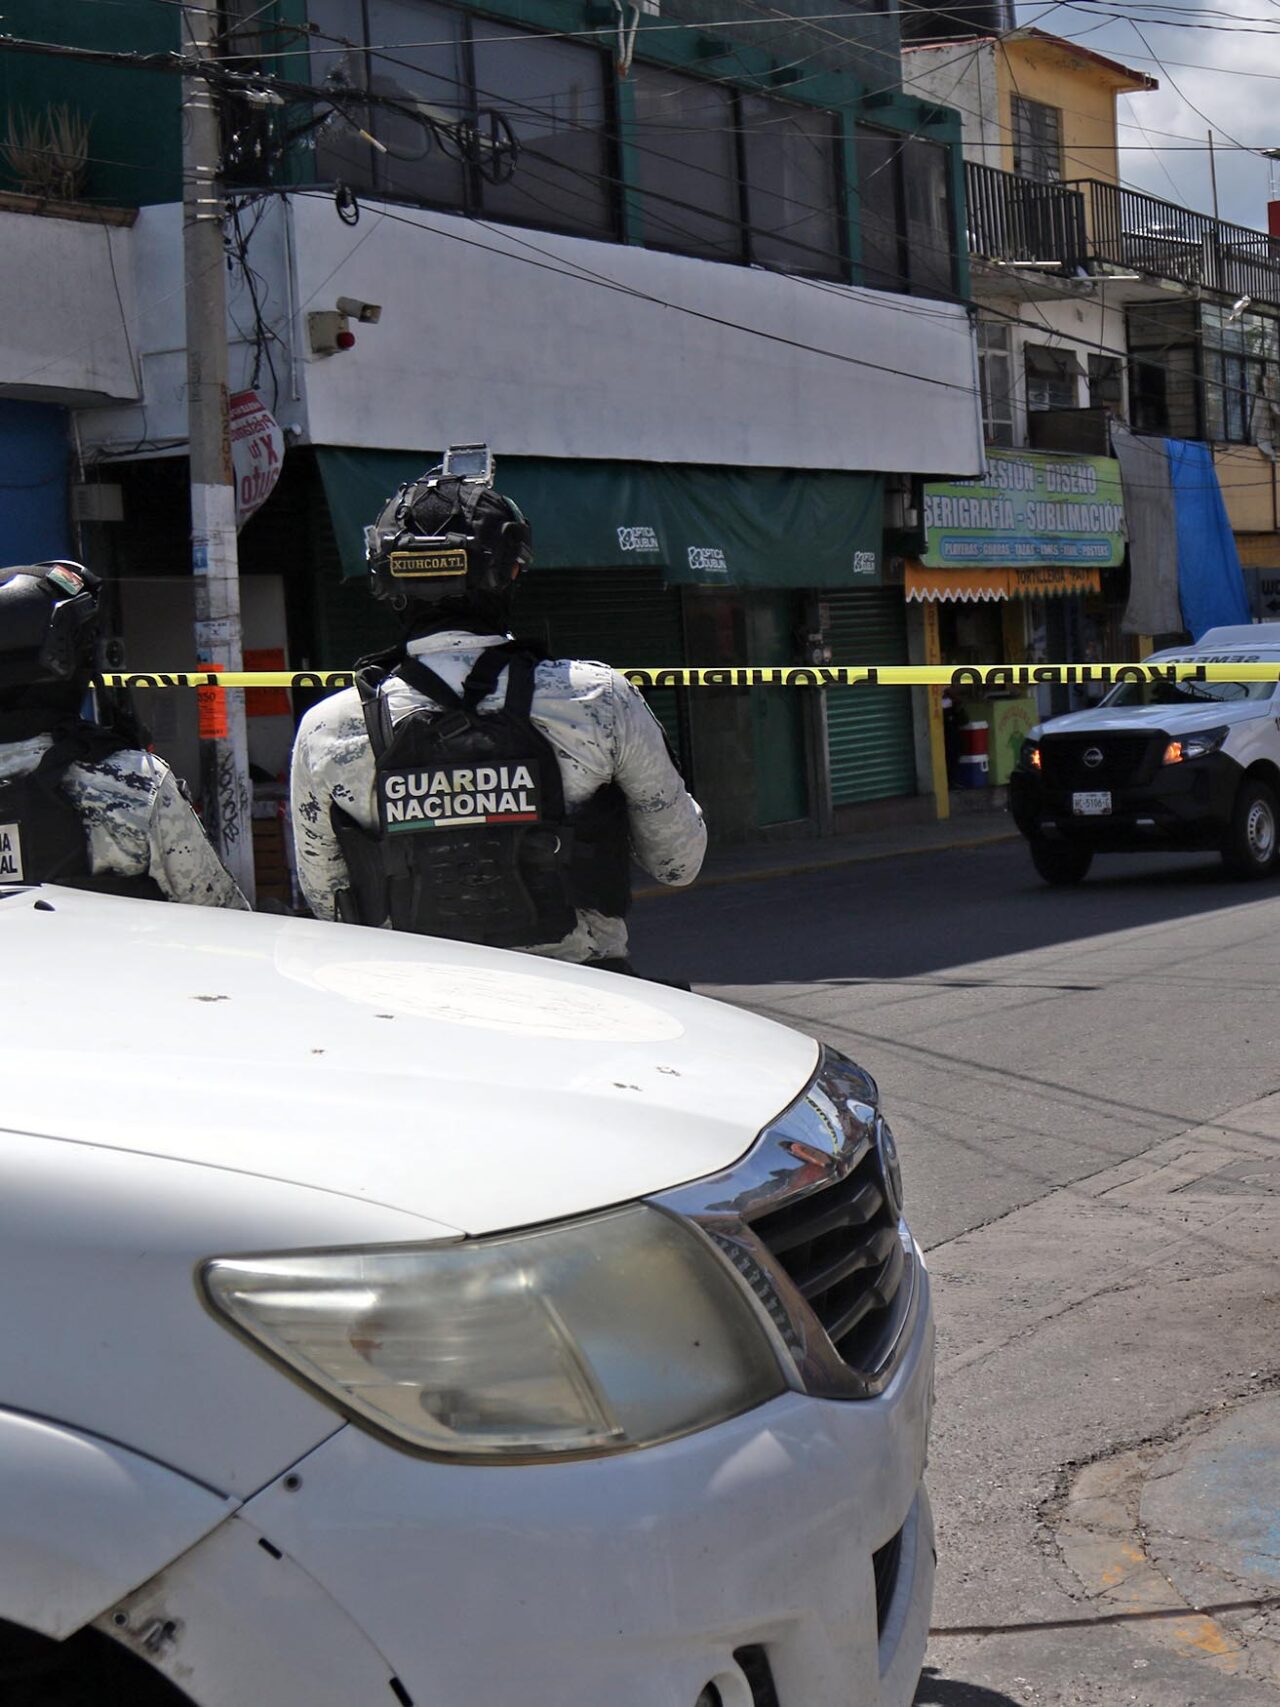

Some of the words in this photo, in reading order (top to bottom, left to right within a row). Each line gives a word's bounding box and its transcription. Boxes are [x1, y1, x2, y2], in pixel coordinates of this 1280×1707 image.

[393, 557, 464, 571] XIUHCOATL
[385, 766, 536, 799] GUARDIA
[386, 792, 537, 823] NACIONAL
